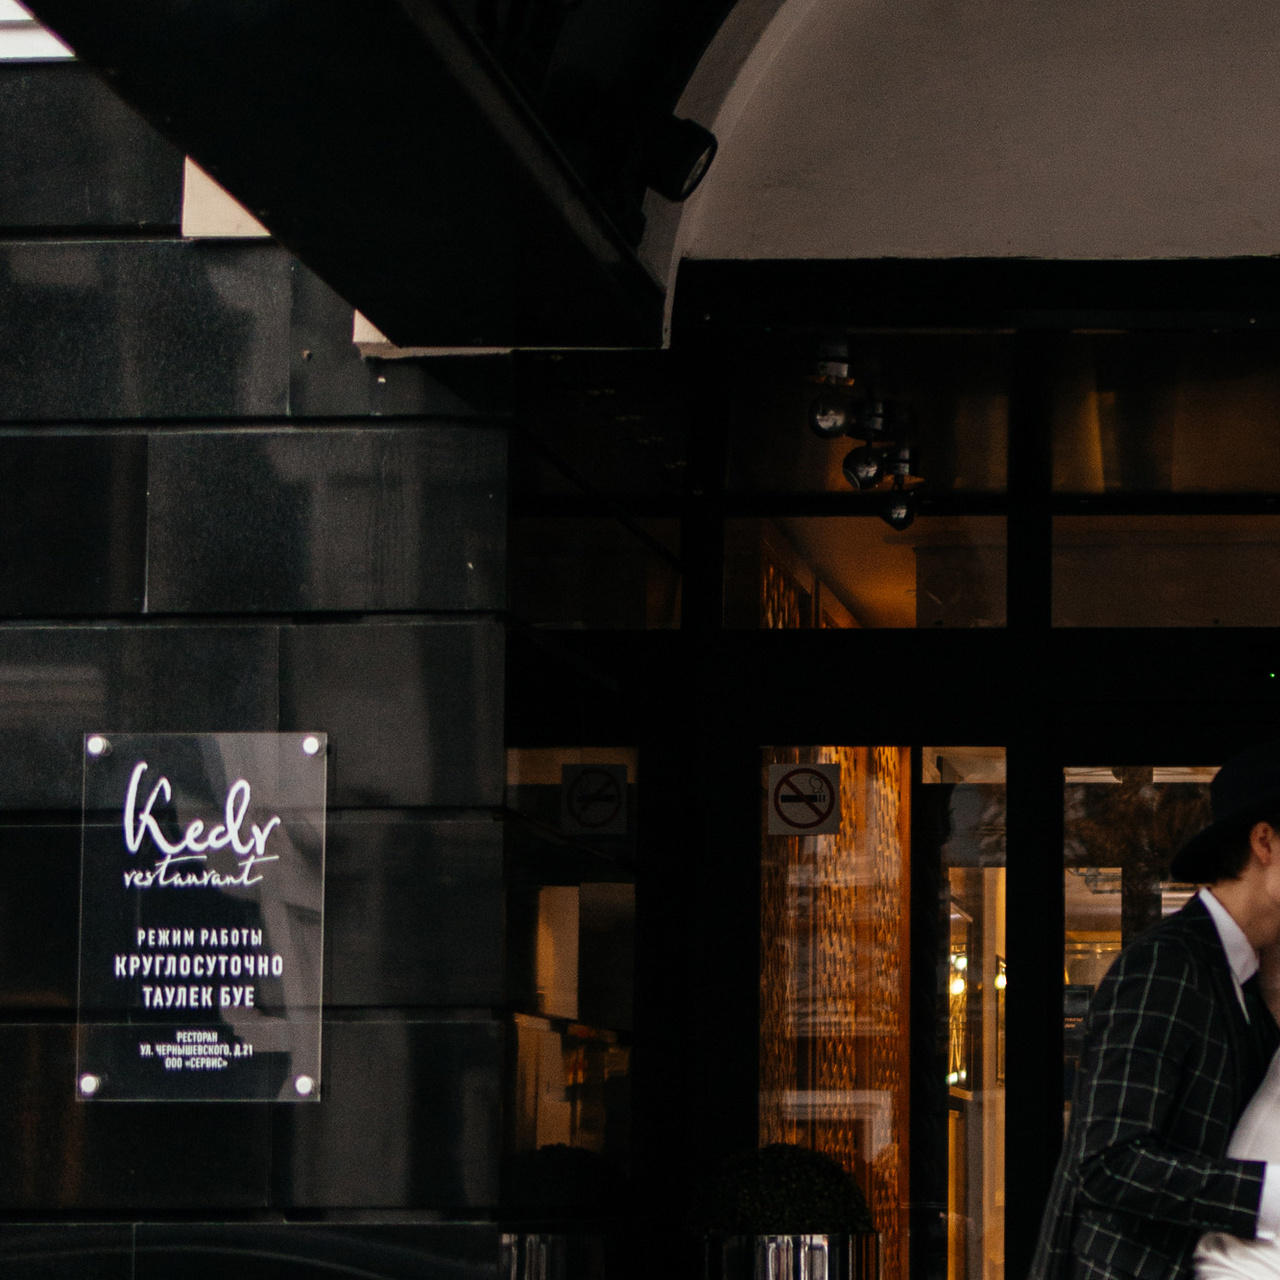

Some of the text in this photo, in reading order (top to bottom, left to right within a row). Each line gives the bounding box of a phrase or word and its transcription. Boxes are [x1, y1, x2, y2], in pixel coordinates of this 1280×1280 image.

[125, 761, 281, 855] Kedr
[124, 854, 279, 889] restaurant
[137, 928, 263, 947] РЕЖИМ РАБОТЫ
[114, 954, 284, 978] КРУГЛОСУТОЧНО
[143, 986, 255, 1008] ТАУЛЕК БУЕ
[176, 1031, 218, 1043] РЕСТОРАН
[140, 1044, 154, 1056] УЛ.
[165, 1057, 228, 1069] ООО «СЕРВИС»
